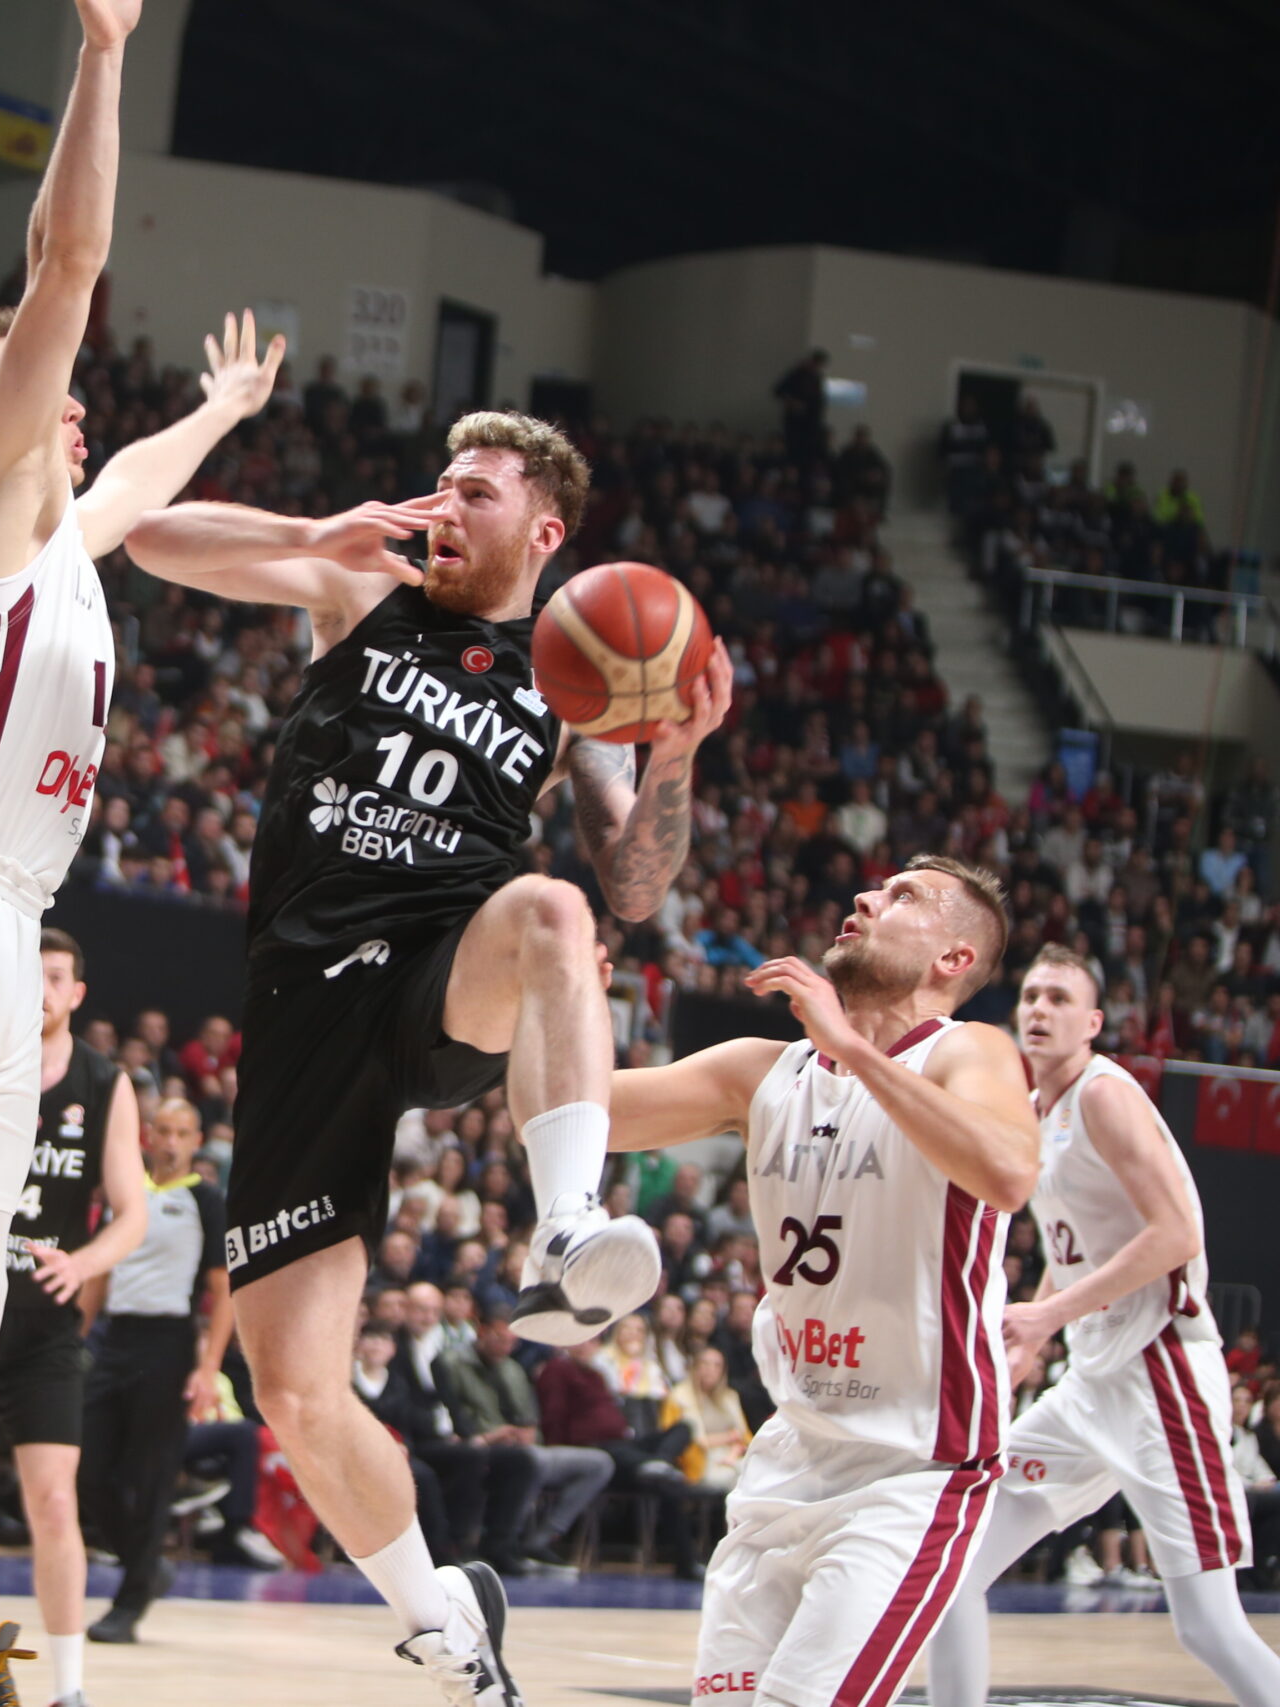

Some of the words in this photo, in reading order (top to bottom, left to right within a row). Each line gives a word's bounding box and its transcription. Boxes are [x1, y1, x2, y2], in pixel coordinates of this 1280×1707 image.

[360, 647, 545, 784] TÜRKİYE
[376, 730, 459, 807] 10
[341, 826, 414, 865] BBVA
[347, 790, 464, 854] Garanti
[30, 1141, 86, 1178] KİYE
[772, 1215, 842, 1286] 25
[846, 1379, 881, 1400] Bar
[695, 1671, 756, 1697] RCLE
